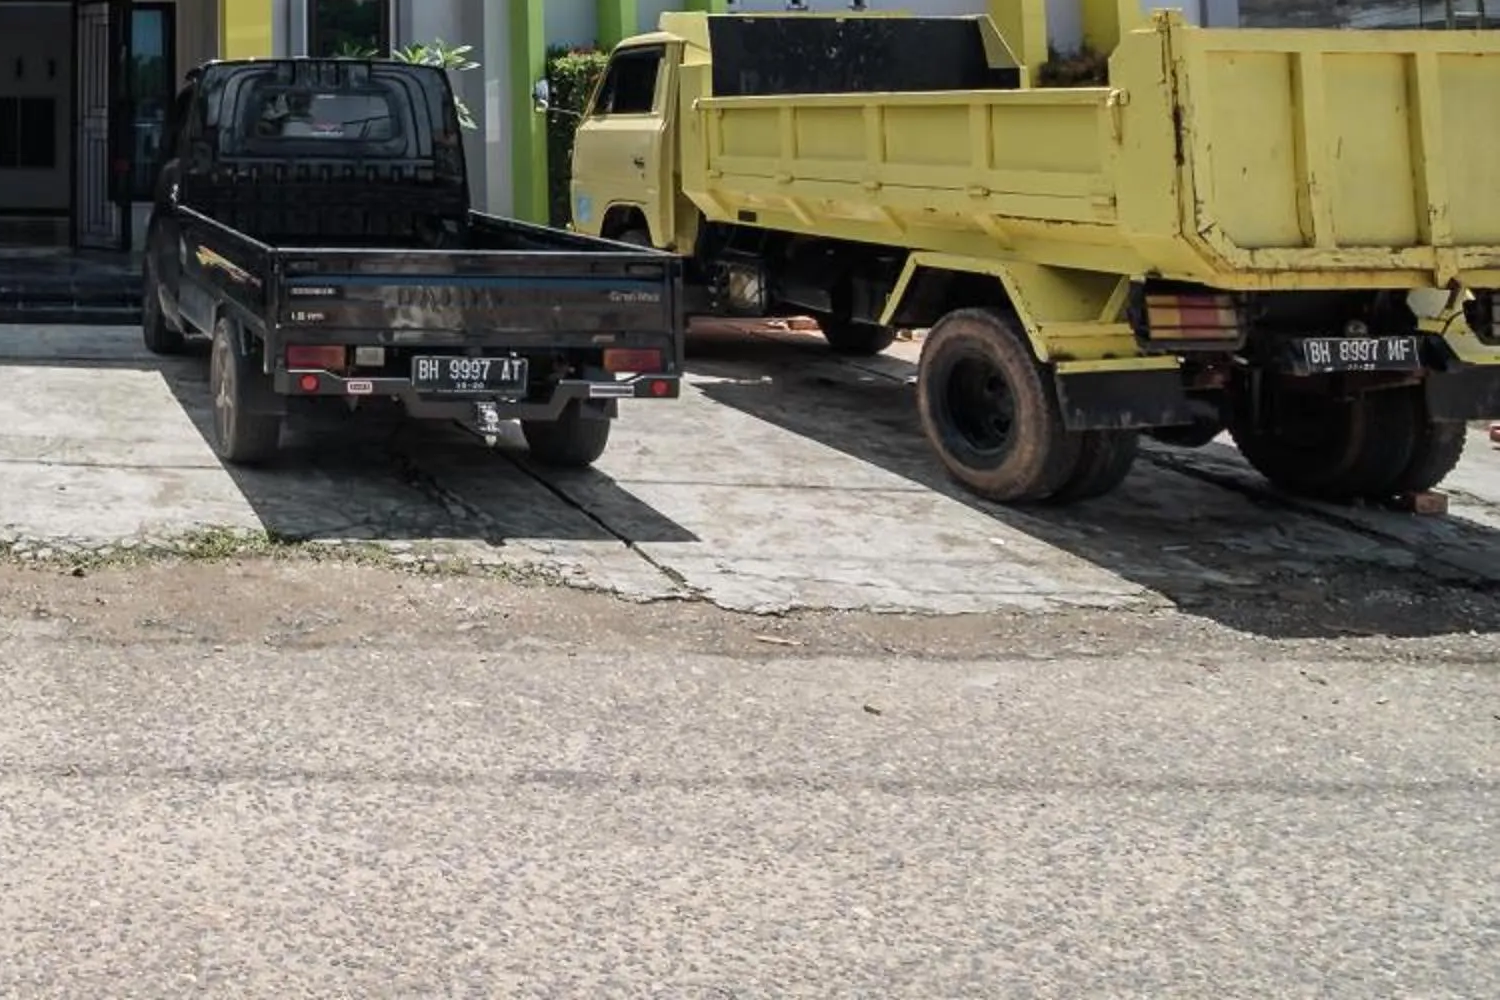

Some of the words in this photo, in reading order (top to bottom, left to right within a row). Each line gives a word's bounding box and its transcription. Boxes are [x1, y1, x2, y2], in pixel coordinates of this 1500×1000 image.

[1309, 341, 1331, 364] BH
[1339, 340, 1379, 361] 8997
[1387, 339, 1411, 361] MF
[418, 359, 439, 380] BH
[449, 359, 491, 381] 9997
[501, 360, 522, 381] AT
